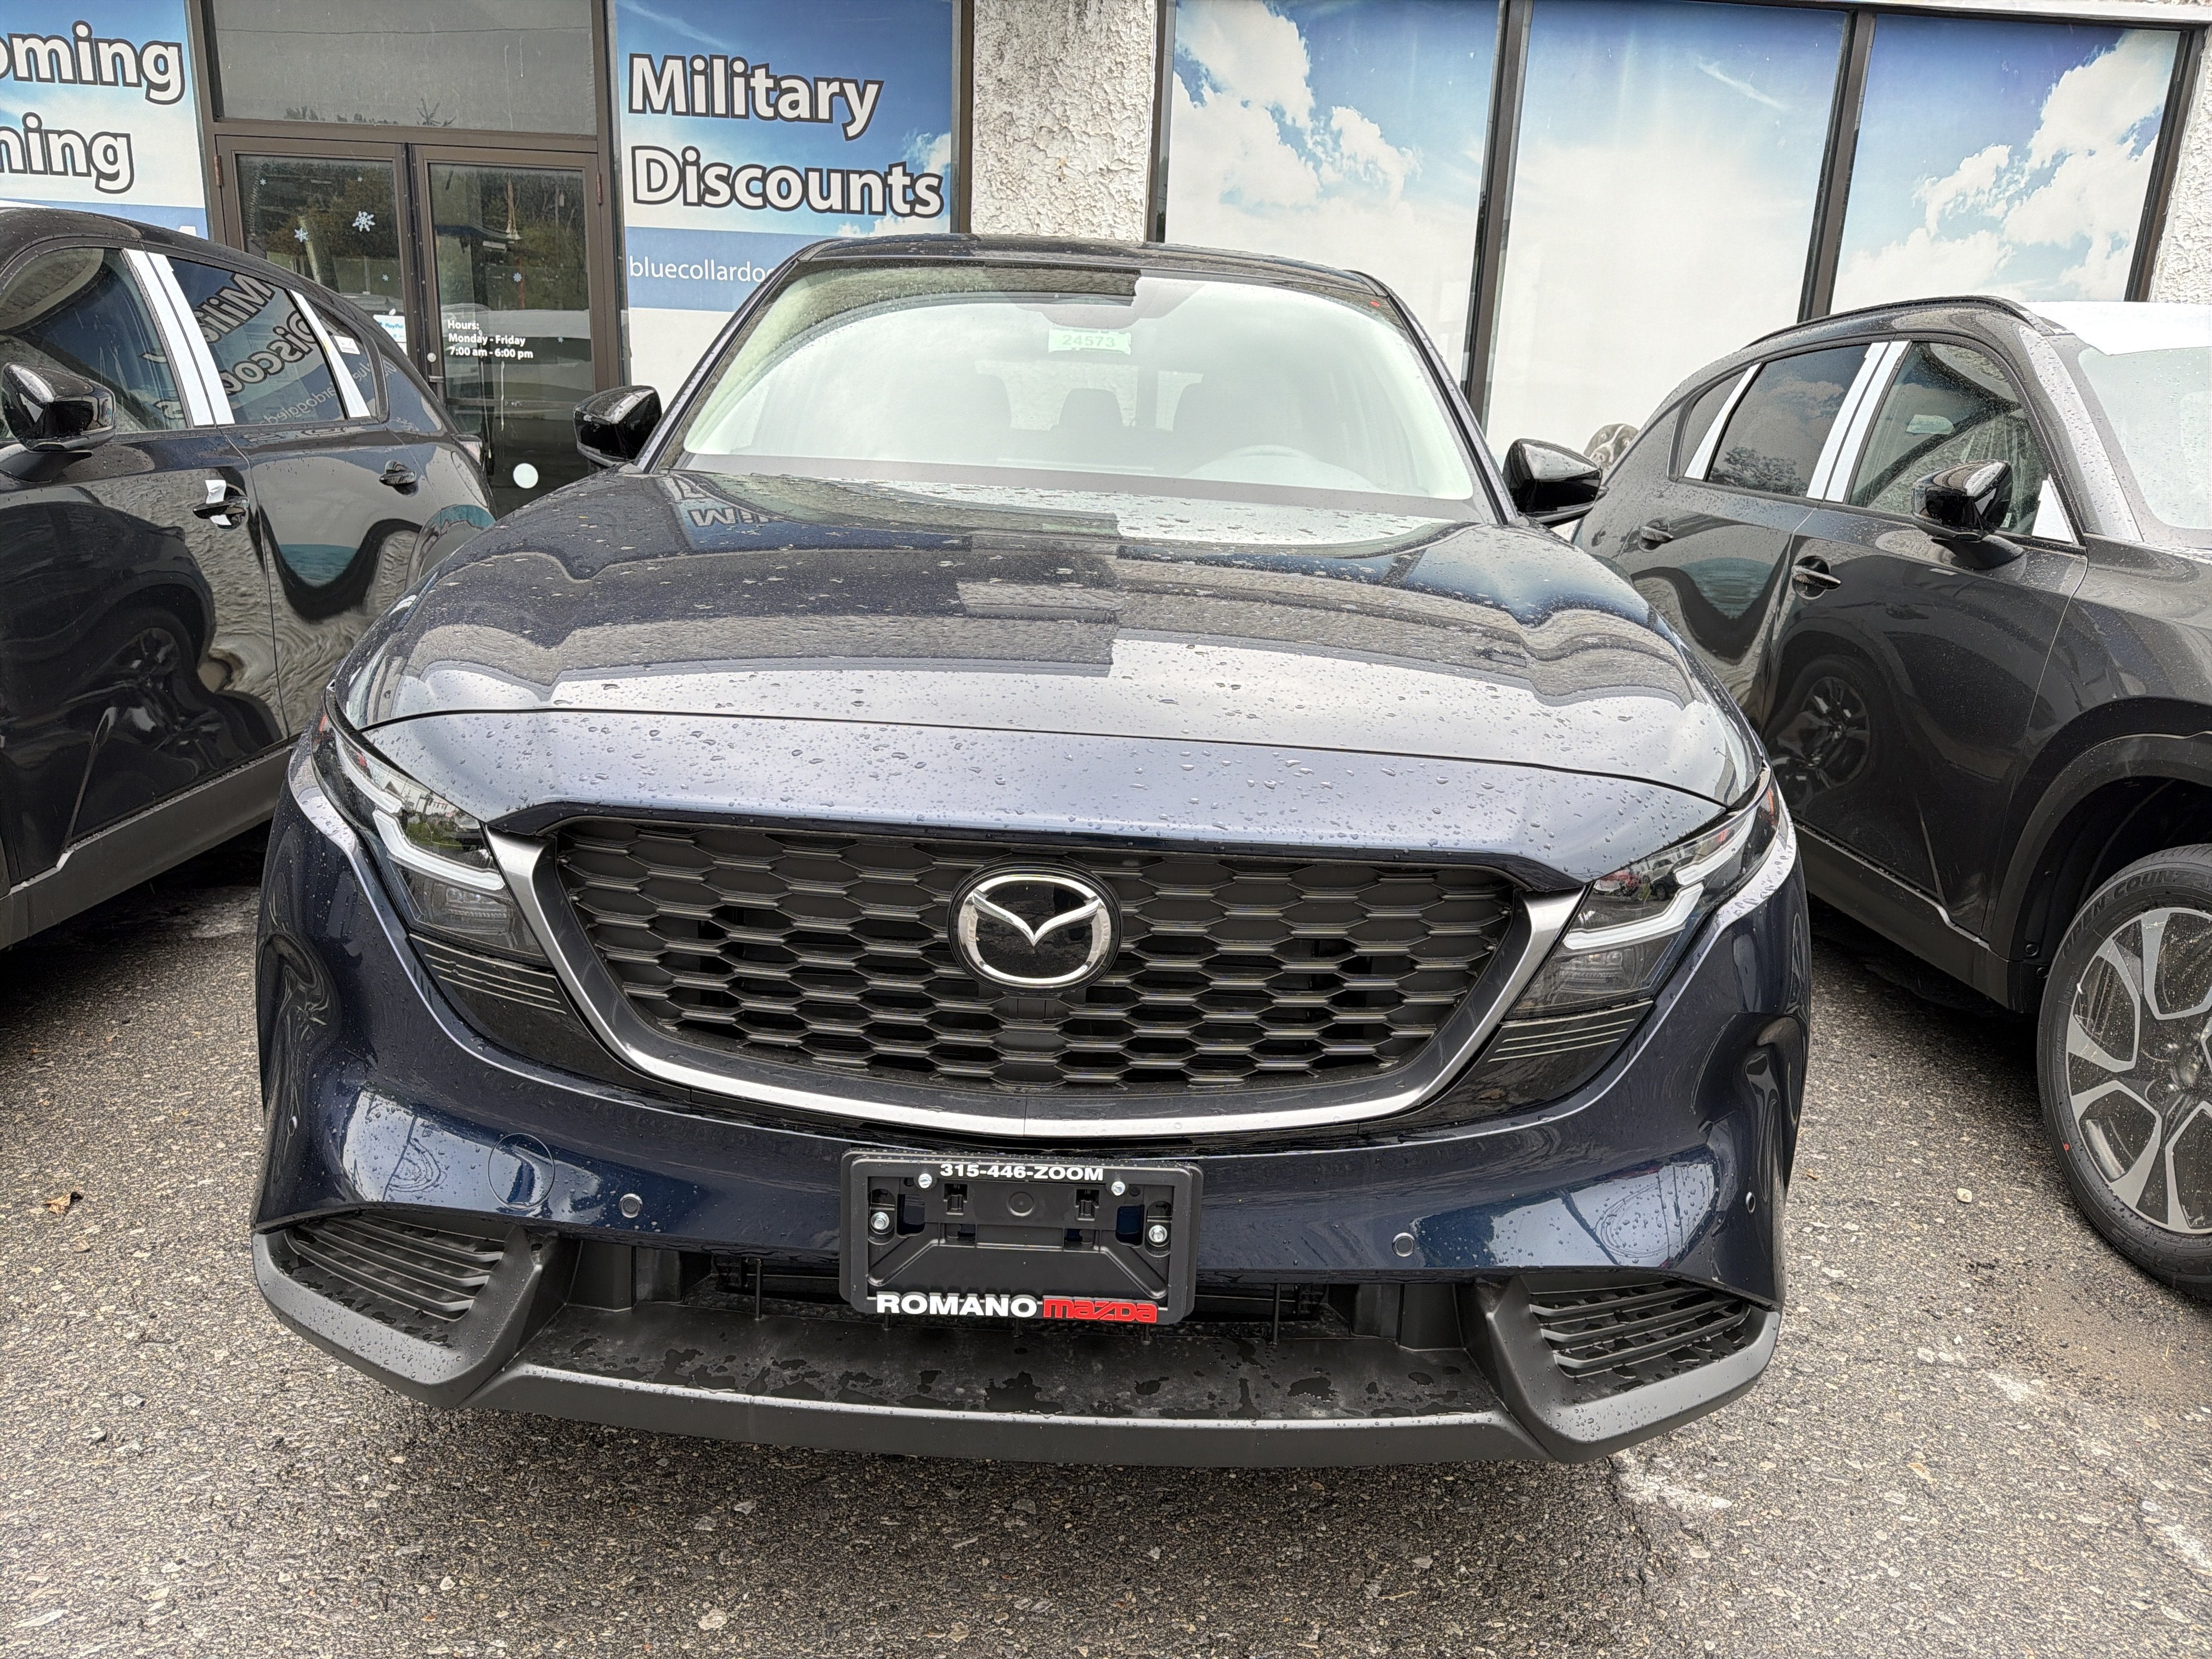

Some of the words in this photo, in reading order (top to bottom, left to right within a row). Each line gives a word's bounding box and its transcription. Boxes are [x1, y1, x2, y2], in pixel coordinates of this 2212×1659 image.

[628, 53, 883, 141] Military
[631, 145, 944, 217] Discounts
[448, 320, 479, 330] Hours:
[448, 332, 488, 346] Monday
[495, 335, 526, 347] Friday
[1062, 334, 1116, 347] 24573
[449, 346, 471, 356] 7:00
[494, 348, 516, 357] 6:00
[517, 349, 534, 360] pm
[940, 1163, 1104, 1181] 315-446-ZOOM
[877, 1293, 1037, 1317] ROMANO
